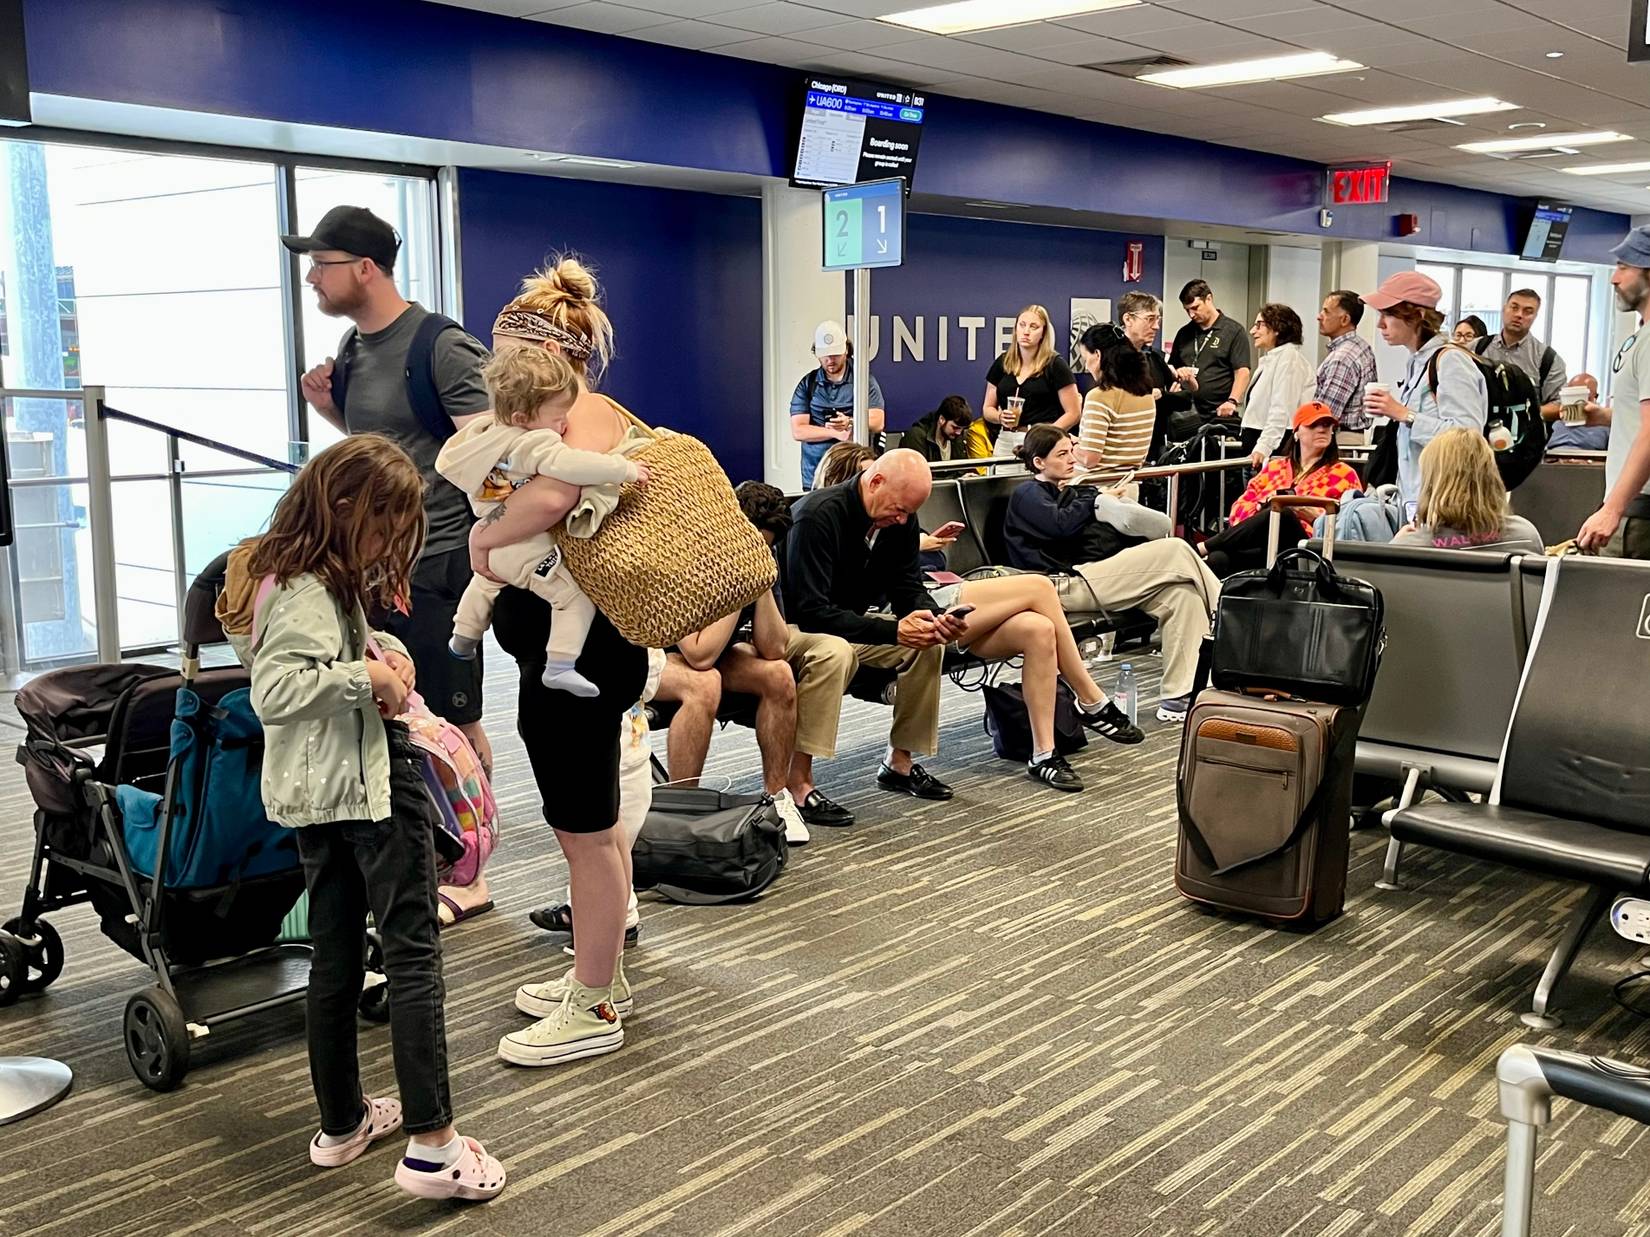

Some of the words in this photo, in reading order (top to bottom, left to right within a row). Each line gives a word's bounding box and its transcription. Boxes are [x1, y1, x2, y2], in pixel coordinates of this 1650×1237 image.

[811, 81, 831, 92] Chicago
[816, 96, 842, 109] UA600
[870, 138, 894, 150] Boarding
[1334, 168, 1385, 203] EXIT
[836, 209, 848, 238] 2
[877, 205, 886, 234] 1
[847, 315, 1055, 361] UNITE
